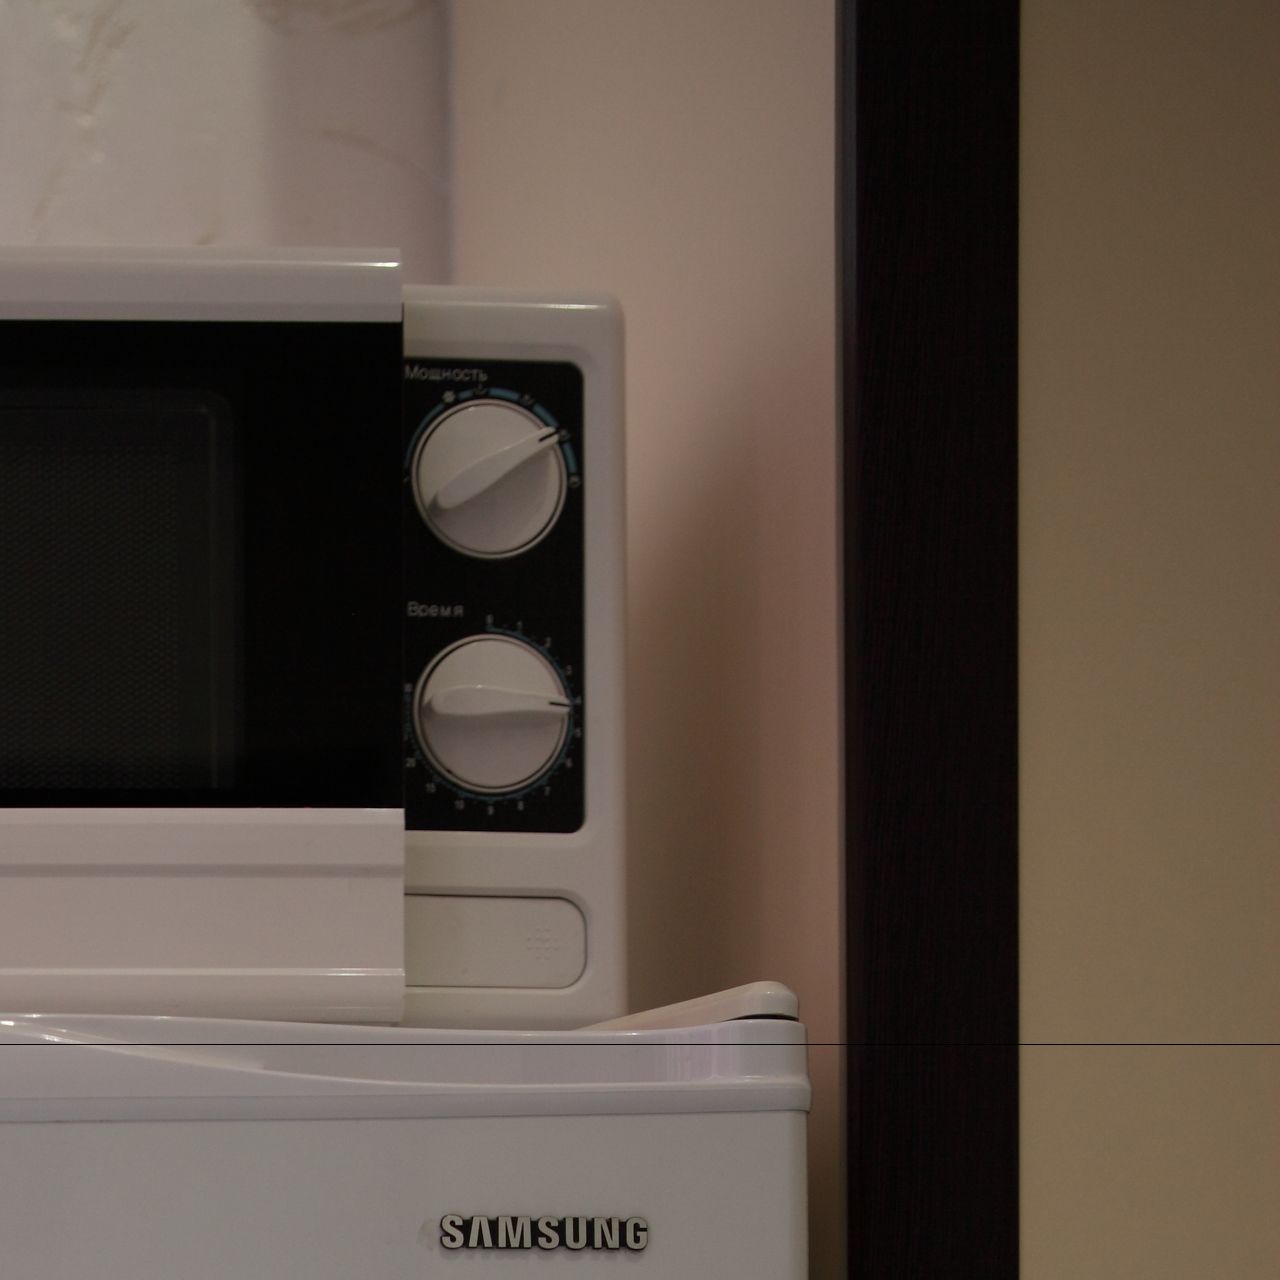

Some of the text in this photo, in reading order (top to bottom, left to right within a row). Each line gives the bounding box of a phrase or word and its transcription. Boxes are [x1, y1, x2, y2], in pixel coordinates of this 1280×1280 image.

[405, 365, 488, 382] Мощность
[407, 602, 464, 617] Время
[440, 1213, 649, 1250] SAMSUNG
